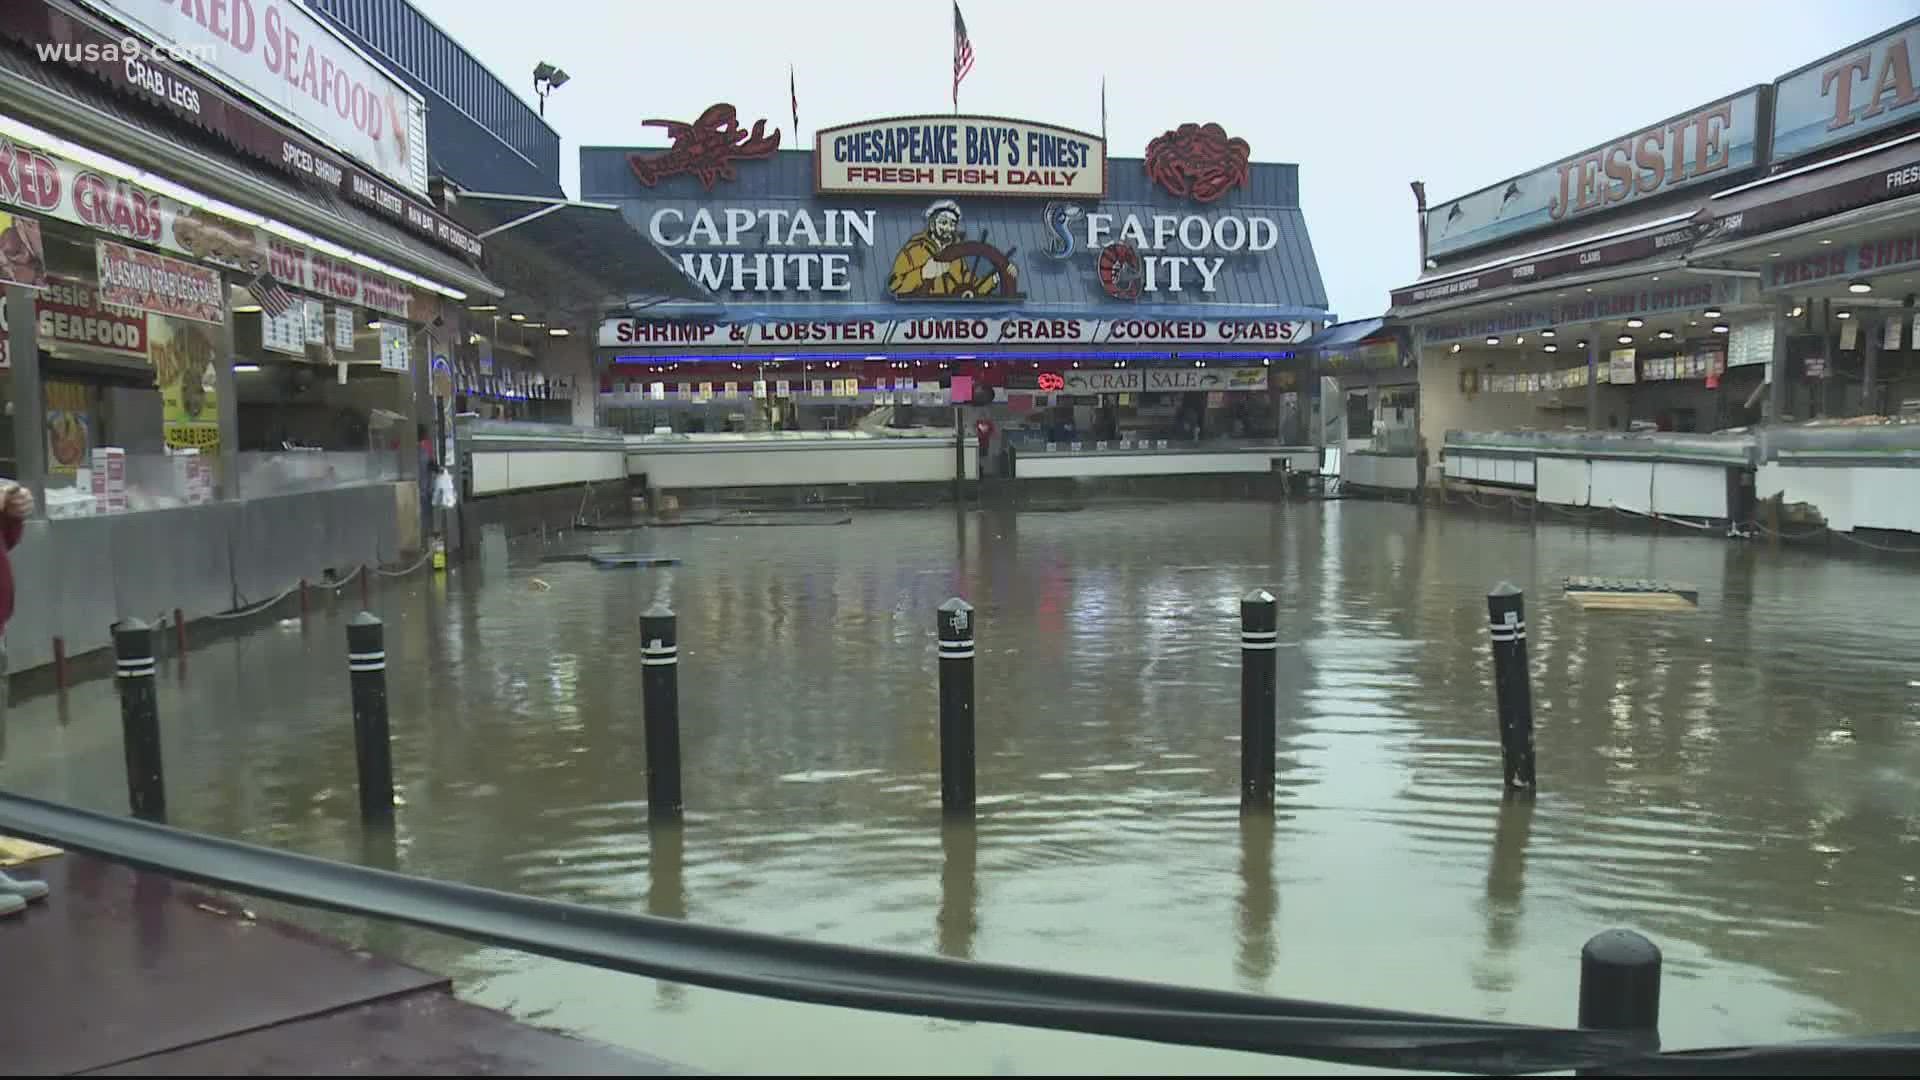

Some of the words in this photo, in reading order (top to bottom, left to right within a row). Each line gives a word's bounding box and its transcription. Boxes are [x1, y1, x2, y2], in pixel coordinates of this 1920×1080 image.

[125, 59, 164, 97] CRAB
[168, 76, 200, 115] LEGS
[264, 5, 383, 141] SEAFOOD
[1821, 38, 1920, 132] TA
[282, 142, 313, 173] SPICED
[834, 125, 958, 163] CHESAPEAKE
[965, 126, 1019, 166] BAY'S
[1027, 131, 1090, 168] FINEST
[1550, 103, 1732, 220] JESSIE
[847, 167, 934, 183] FRESH
[941, 168, 998, 185] FISH
[1007, 170, 1078, 186] DAILY
[73, 171, 162, 243] CRABS
[650, 208, 876, 246] CAPTAIN
[104, 257, 151, 289] ALASKAN
[269, 241, 304, 285] HOT
[312, 255, 358, 298] SPICED
[681, 253, 851, 291] WHITE
[38, 308, 141, 348] SEAFOOD
[617, 322, 715, 342] SHRIMP
[729, 323, 745, 341] &
[761, 322, 875, 340] LOBSTER
[904, 321, 988, 340] JUMBO
[1001, 321, 1081, 340] CRABS
[1111, 321, 1206, 340] COOKED
[1219, 321, 1293, 340] CRABS
[1089, 372, 1138, 390] CRAB
[1151, 371, 1198, 389] SALE
[170, 428, 194, 445] CRAB
[196, 428, 218, 445] LEGS
